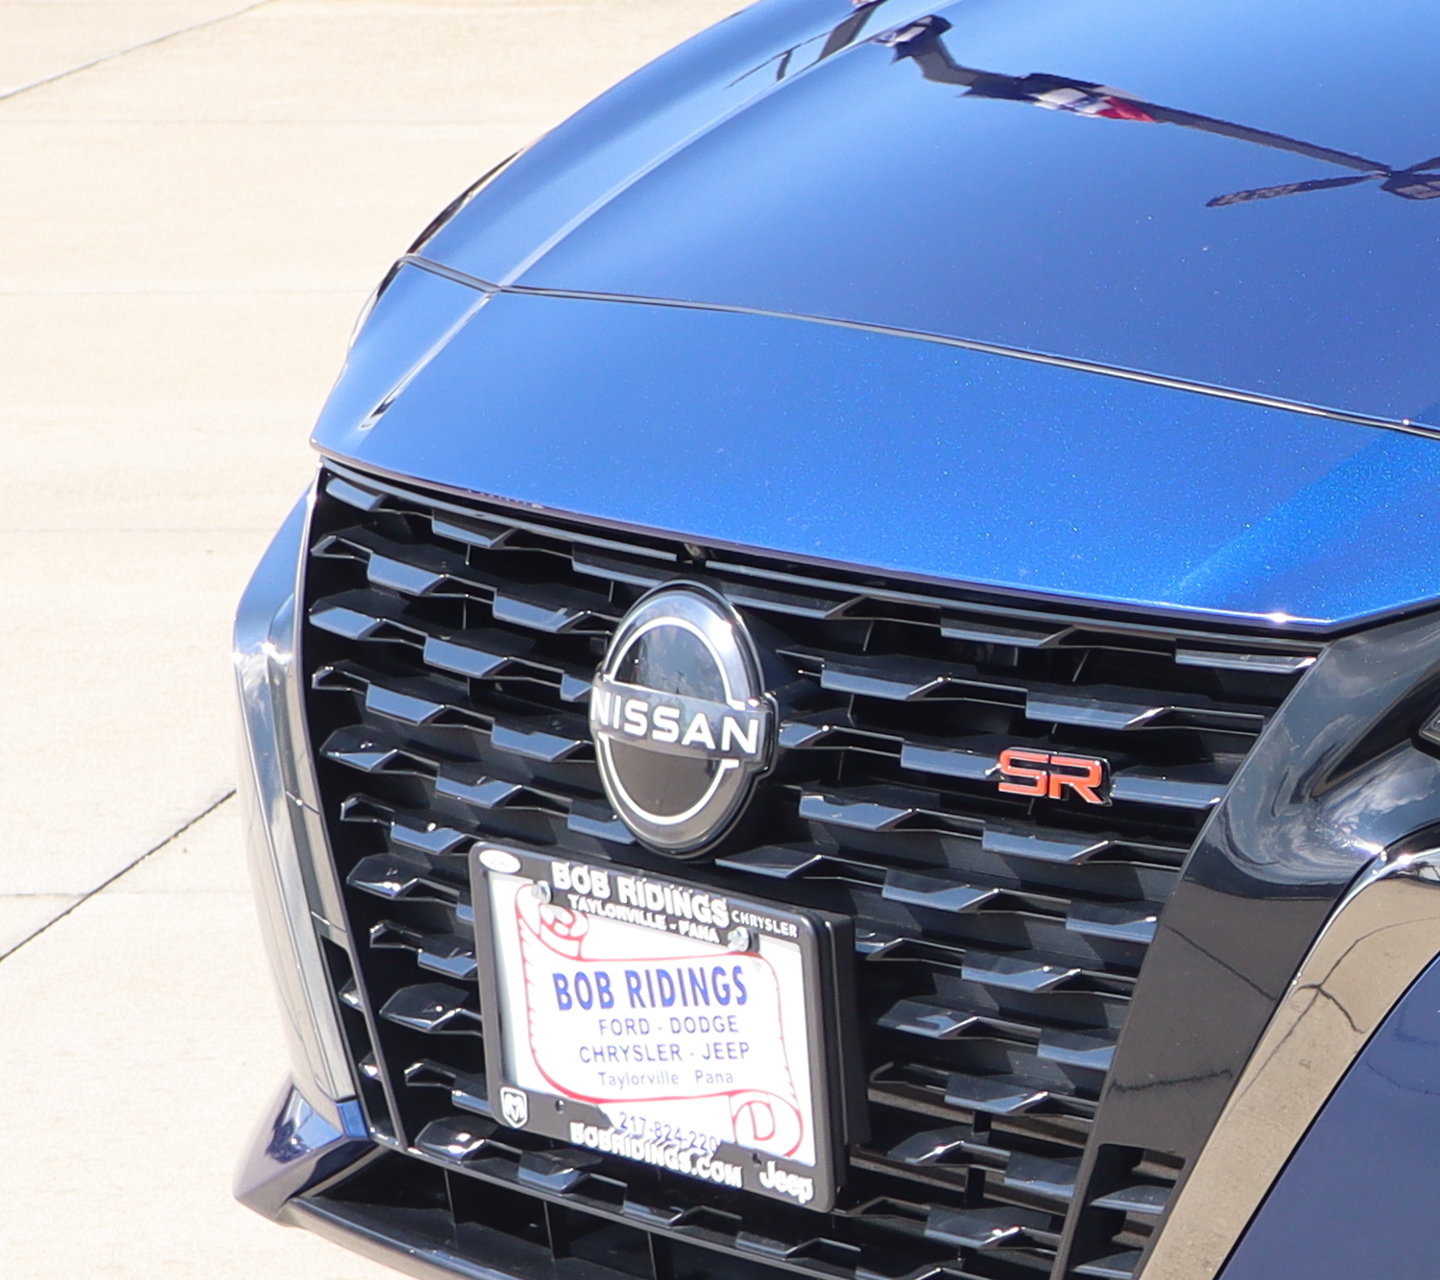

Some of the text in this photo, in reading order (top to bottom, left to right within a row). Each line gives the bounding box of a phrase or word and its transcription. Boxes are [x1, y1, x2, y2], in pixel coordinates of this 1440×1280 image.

[590, 684, 759, 754] NISSAN
[998, 748, 1106, 805] SR
[551, 860, 612, 900] BOB
[616, 874, 731, 929] RIDINGS
[731, 910, 799, 939] CHRYSLER
[567, 893, 667, 931] TAYLORVILLE
[678, 919, 720, 945] PANA
[551, 964, 748, 1011] BOB RIDINGS
[598, 1017, 650, 1037] FORD
[669, 1015, 739, 1035] DODGE
[578, 1043, 683, 1064] CHRYSLER
[702, 1041, 750, 1061] JEEP
[597, 1069, 734, 1091] Taylorville Pana
[569, 1121, 743, 1188] BOBRIDINGS.COM
[758, 1160, 814, 1204] Jeep
